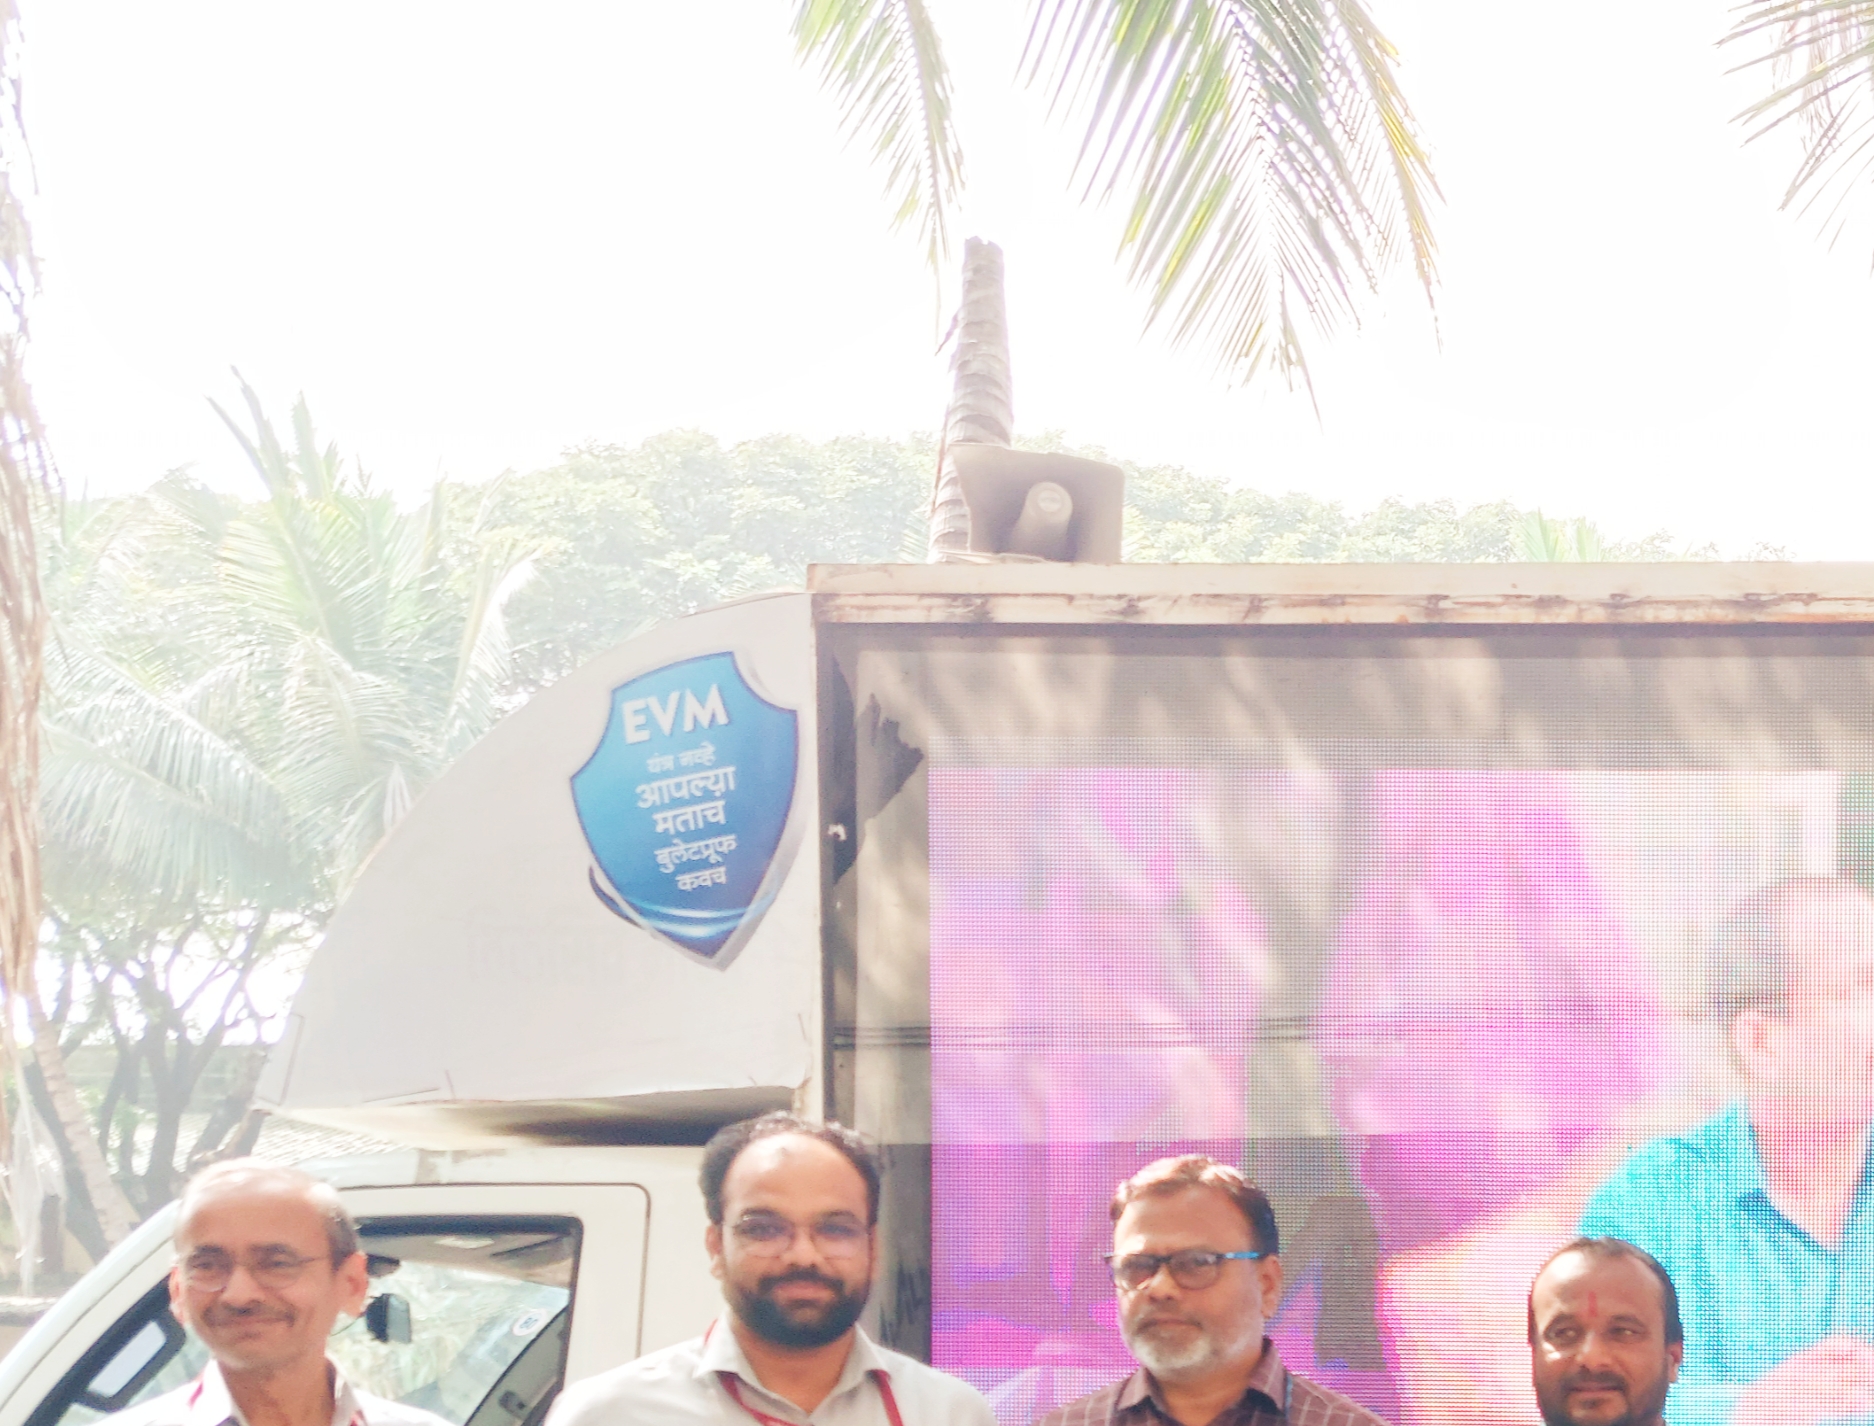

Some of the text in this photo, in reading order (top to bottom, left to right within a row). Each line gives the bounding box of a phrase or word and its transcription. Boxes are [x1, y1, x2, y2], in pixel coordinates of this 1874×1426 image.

[622, 683, 730, 745] EVM
[635, 765, 737, 809] आपल्या
[675, 866, 727, 891] कवच
